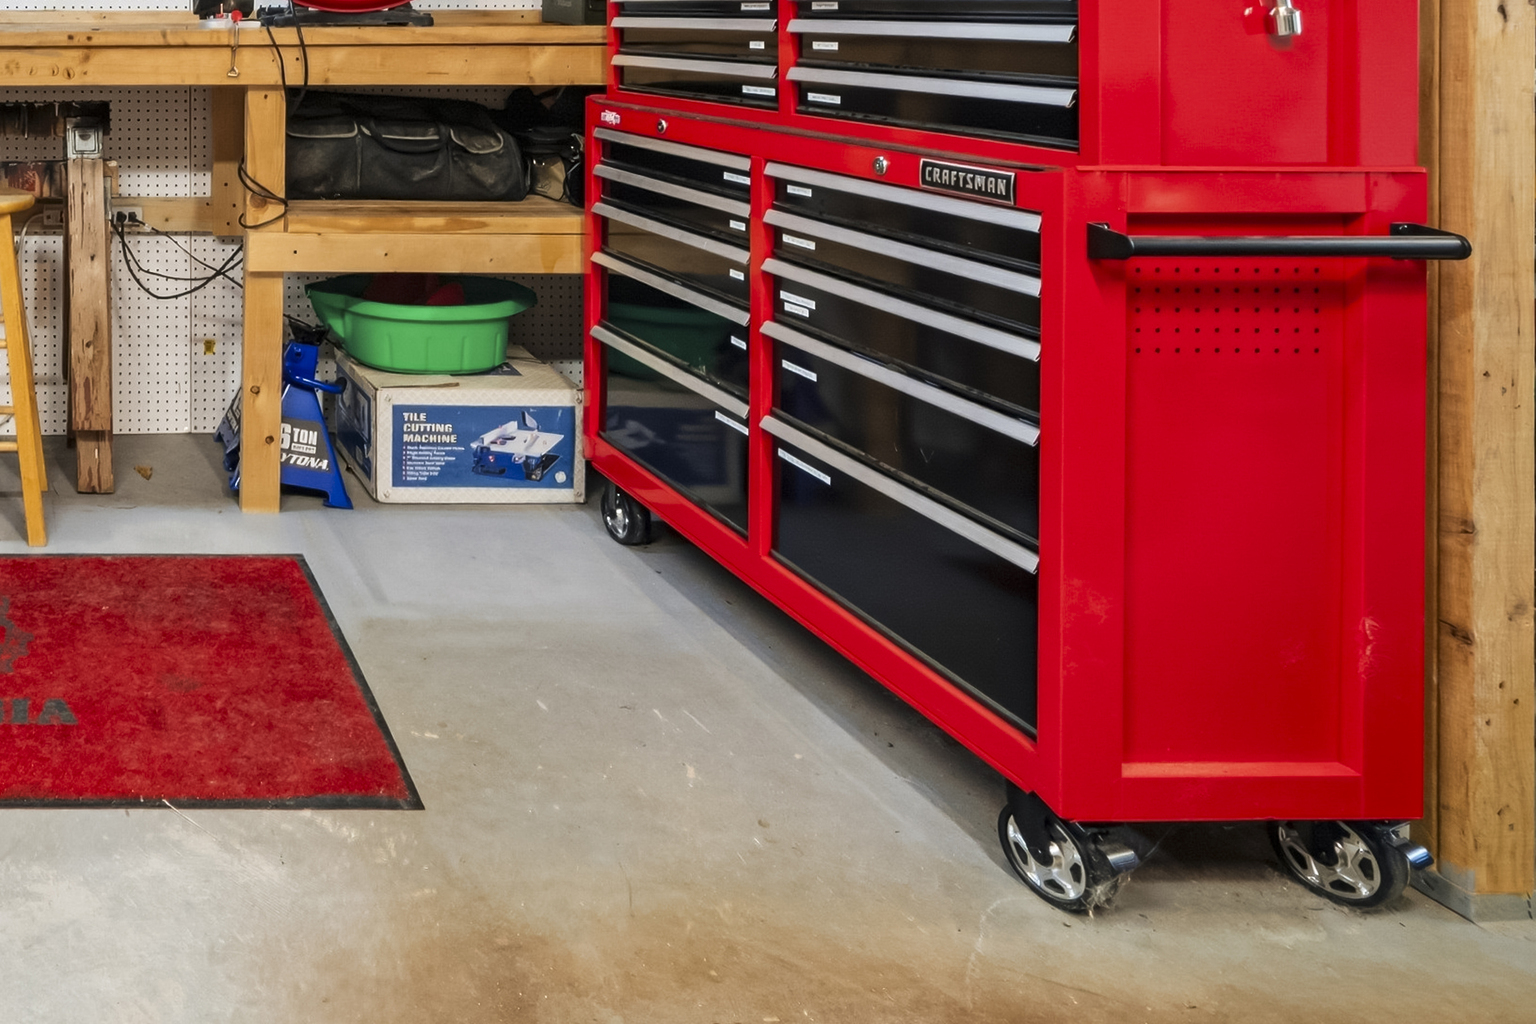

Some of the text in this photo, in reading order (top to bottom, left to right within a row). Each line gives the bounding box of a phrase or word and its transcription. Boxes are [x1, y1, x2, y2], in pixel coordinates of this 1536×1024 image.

[925, 166, 1007, 196] CRAFTSMAN
[403, 412, 427, 422] TILE
[403, 423, 453, 433] CUTTING
[292, 427, 318, 446] TON
[403, 433, 458, 443] MACHINE
[280, 452, 329, 471] YTONA
